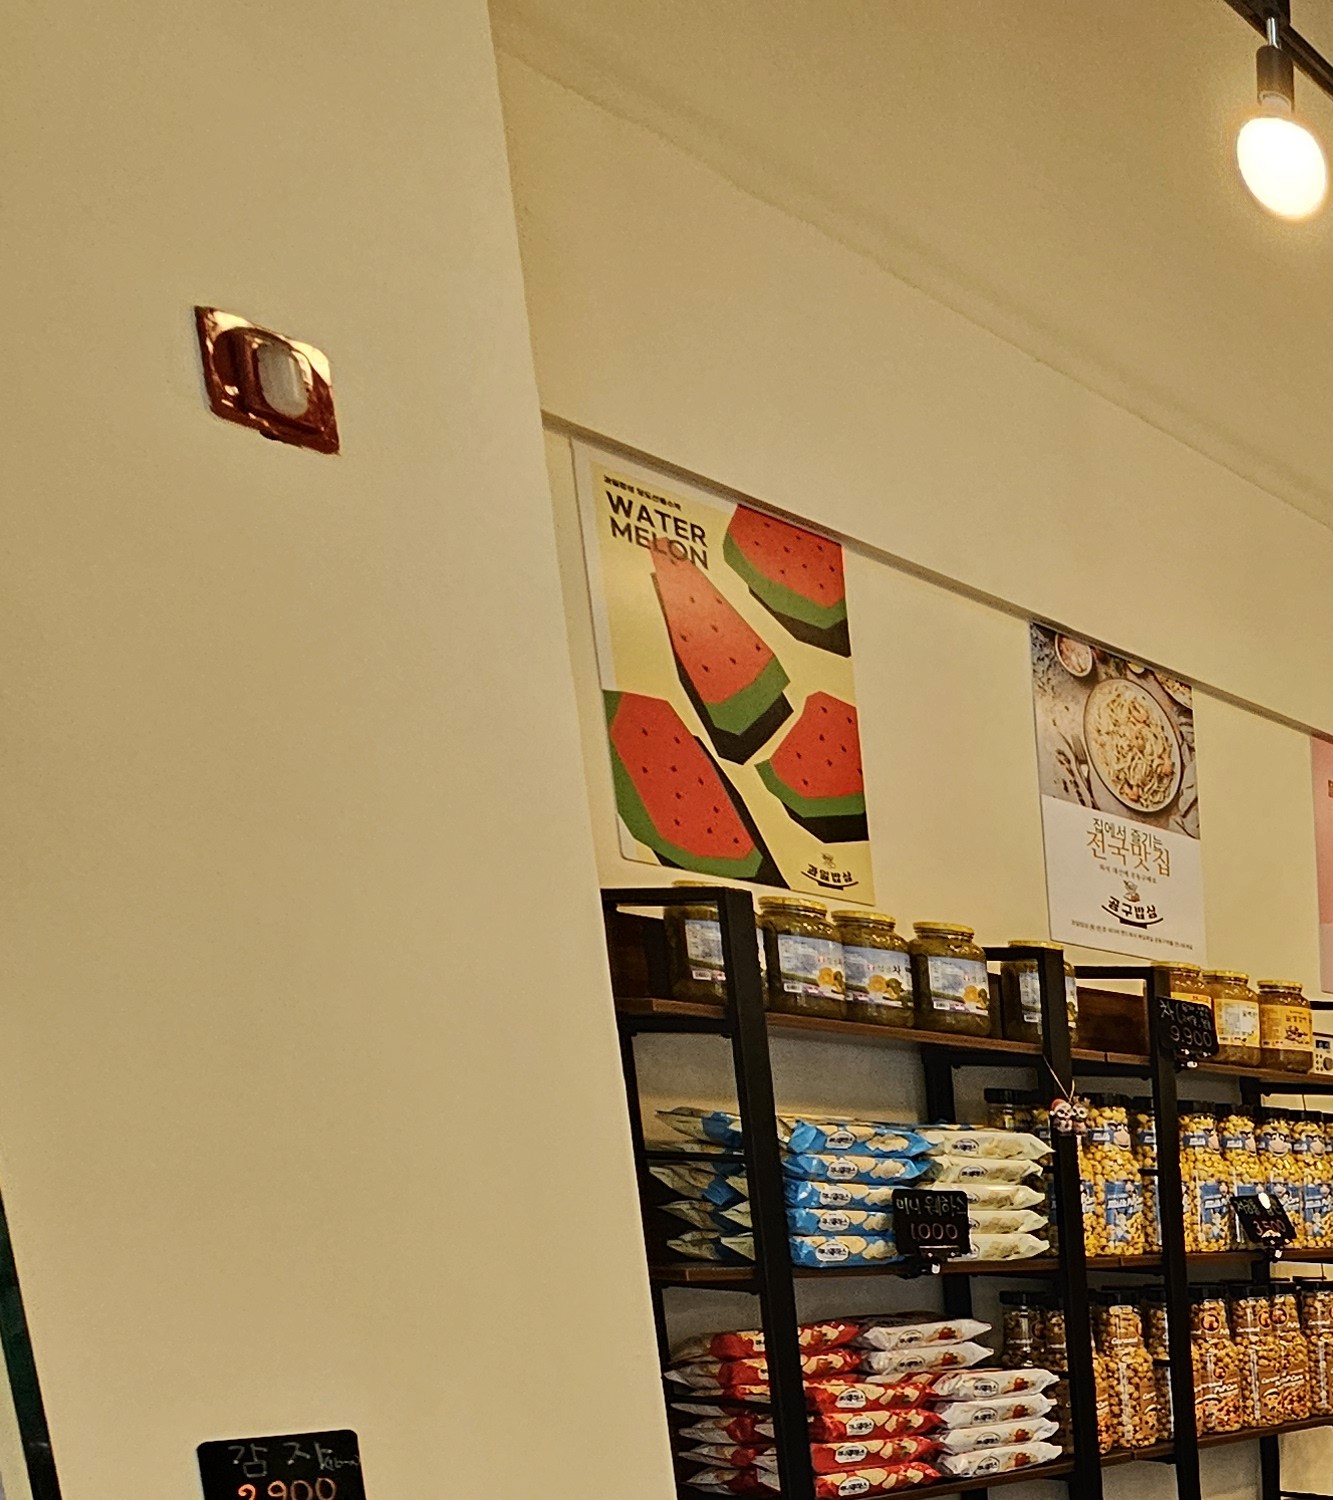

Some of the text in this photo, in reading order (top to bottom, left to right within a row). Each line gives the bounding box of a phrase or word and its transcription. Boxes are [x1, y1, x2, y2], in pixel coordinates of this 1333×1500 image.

[606, 490, 708, 548] WATER
[609, 515, 709, 570] MELON
[1093, 818, 1163, 847] 집에서 즐기는
[1086, 830, 1170, 876] 전국맛집
[1108, 895, 1158, 919] 공구밥상
[896, 1197, 920, 1215] 미니
